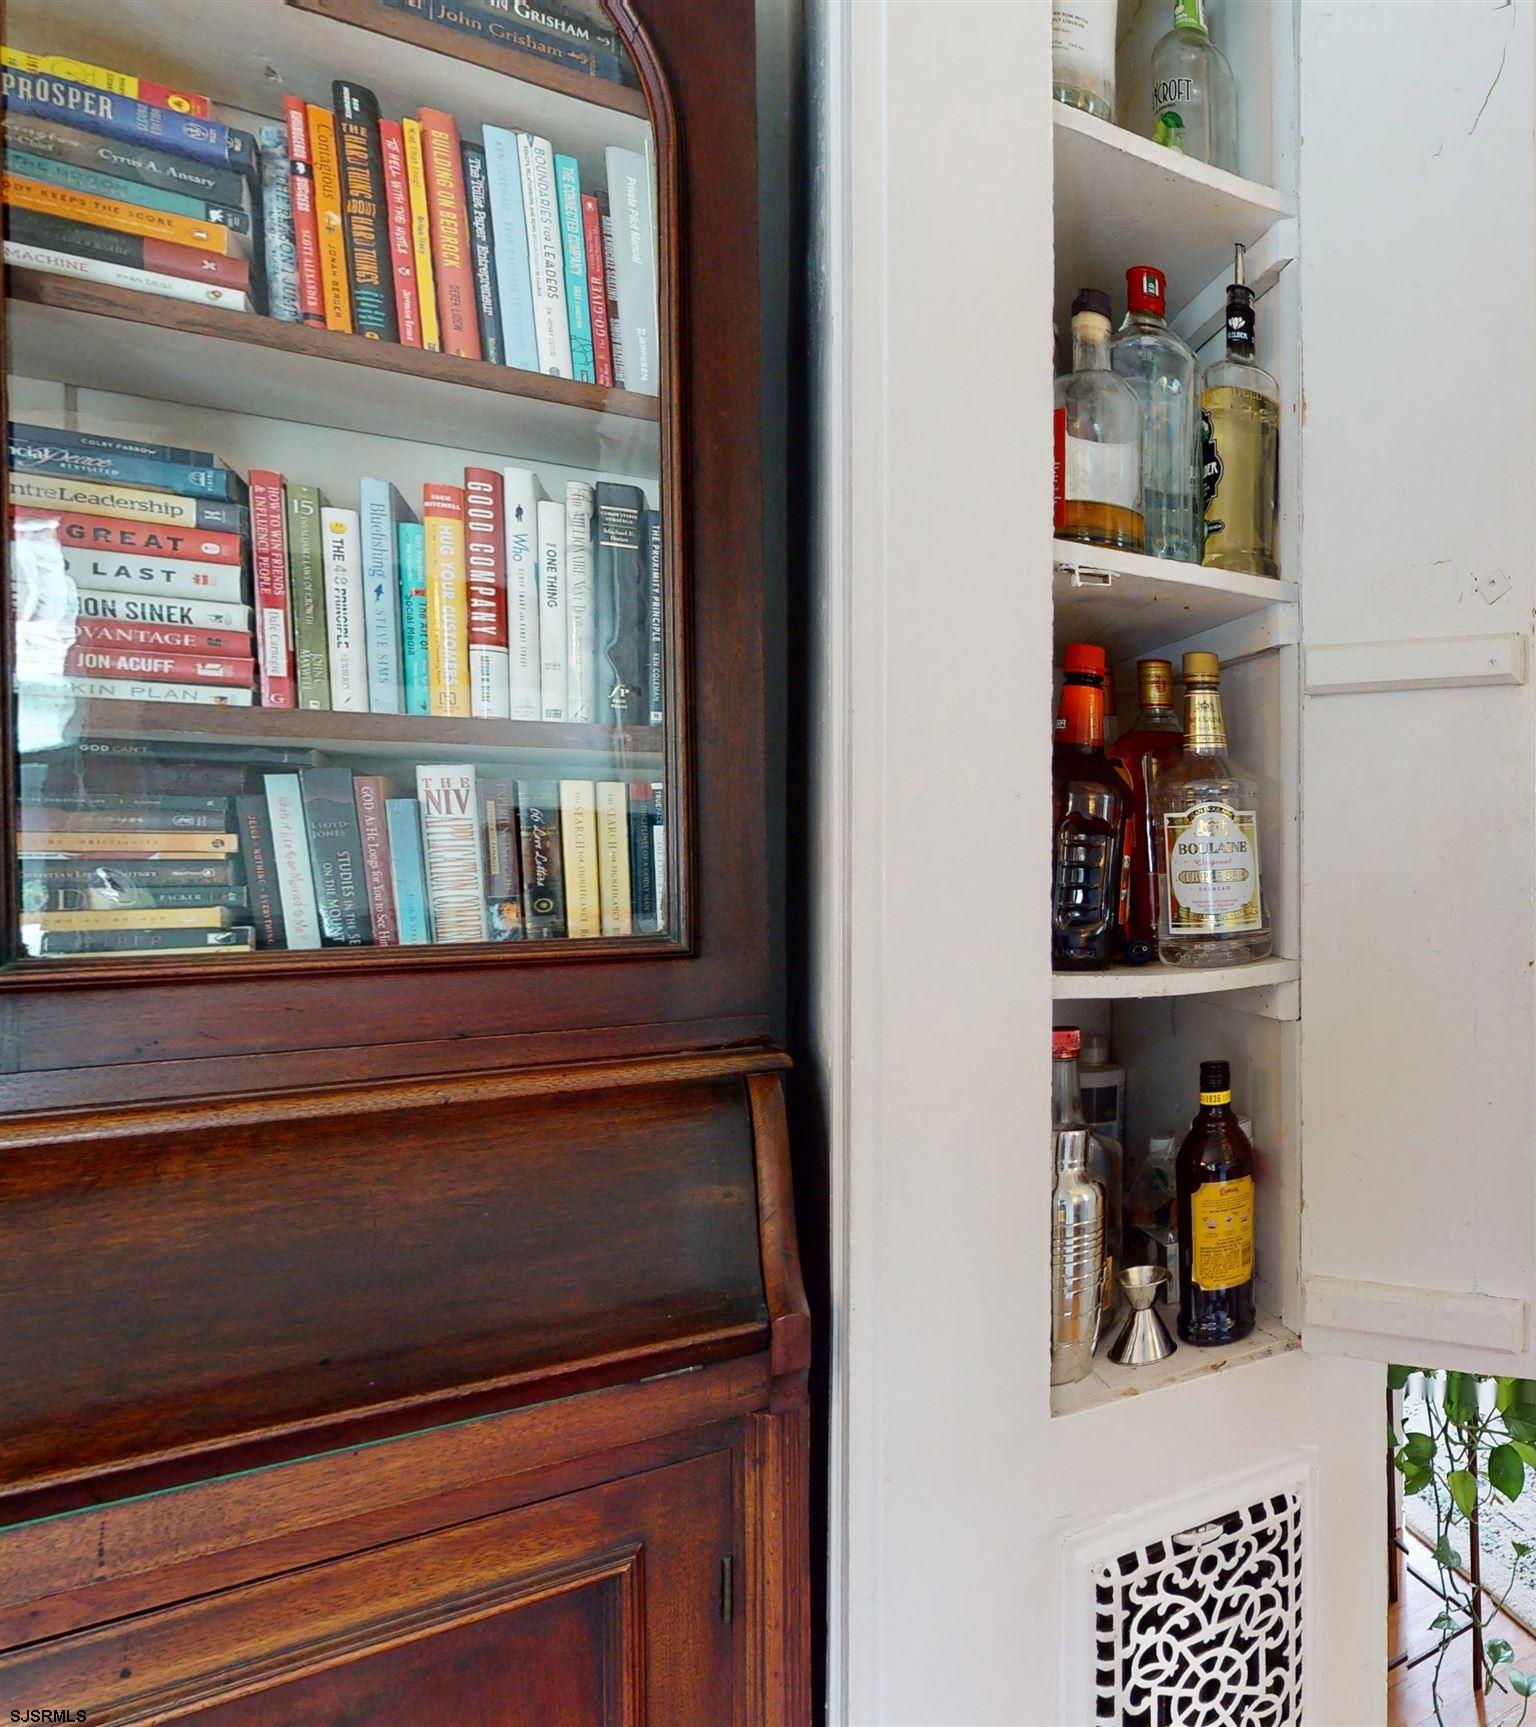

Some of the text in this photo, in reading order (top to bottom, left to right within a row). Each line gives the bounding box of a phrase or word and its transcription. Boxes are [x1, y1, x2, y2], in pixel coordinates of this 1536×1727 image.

[437, 2, 482, 32] John
[489, 23, 562, 58] Grisham
[514, 0, 589, 41] GRISHAM
[2, 72, 113, 120] PROSPER
[341, 122, 368, 136] THE
[386, 138, 399, 151] TO
[98, 149, 145, 168] Cyrus
[146, 161, 162, 174] A.
[167, 166, 216, 190] Ansary
[316, 124, 334, 200] Contagious
[344, 135, 368, 166] HARD
[388, 153, 402, 177] HELL
[347, 167, 372, 199] THING
[391, 181, 404, 204] WITH
[534, 148, 552, 224] BOUNDARIES
[562, 167, 577, 182] THE
[41, 189, 86, 206] KEEPS
[94, 201, 120, 214] THE
[128, 211, 176, 227] SCORE
[431, 130, 460, 269] BUILDING ON BEDROCK
[563, 183, 579, 231] CONNECTED
[626, 176, 642, 264] Private Pilot Manual
[277, 206, 294, 266] REASON
[351, 216, 379, 286] HARD THINGS
[395, 226, 409, 255] HUSTLE
[470, 158, 493, 316] The Toilet Paper Entrepreneur
[543, 226, 551, 242] FOR
[567, 233, 582, 277] COMPANY
[5, 247, 90, 273] MACHINE
[301, 230, 318, 307] SCOTT ALEXANDER
[328, 244, 342, 318] JONAH BERGER
[544, 245, 558, 299] LEADERS
[282, 277, 298, 320] JUMP
[591, 277, 606, 338] GO-GIVER
[48, 446, 112, 468] Peace
[10, 481, 184, 518] ntreLeadership
[66, 523, 184, 551] GREAT
[255, 496, 269, 554] INFLUENCE
[267, 487, 284, 596] HOW TO WIN FRIENDS
[369, 503, 386, 577] Bluefishing
[571, 511, 586, 576] MILLIONAIRE
[467, 481, 497, 636] GOOD COMPANY
[512, 533, 529, 562] Who
[546, 550, 557, 574] ONE
[92, 562, 176, 582] LAST
[259, 555, 271, 594] PEOPLE
[547, 575, 558, 609] THING
[651, 525, 661, 642] THE PRINCIPLE
[125, 601, 194, 625] SINEK
[332, 538, 349, 649] THE PRINCIPLE
[418, 602, 427, 619] The
[440, 525, 458, 686] HUG YOUR CUSTOMERS
[268, 611, 283, 674] Dale Carnegie
[405, 595, 416, 655] Social Media
[419, 623, 427, 638] Art
[77, 652, 175, 674] JON ACUFF
[312, 653, 324, 676] JOHN
[375, 610, 389, 684] STEVE SIMS
[300, 649, 313, 690] MAXWELL
[131, 686, 198, 702] PLAN
[79, 744, 110, 752] GOD
[422, 777, 470, 788] THE
[424, 789, 471, 816] NIV
[313, 829, 346, 838] JONES
[530, 808, 544, 822] 66
[574, 806, 585, 849] SEARCH
[607, 806, 618, 849] SEARCH
[640, 805, 649, 849] DISCIPLINES
[425, 816, 478, 892] APPLICATION
[534, 851, 547, 887] Letters
[642, 850, 649, 860] OF
[1178, 841, 1247, 855] BOULAINE
[337, 850, 357, 930] STUDIES IN THE
[365, 816, 388, 929] As He Longs for You to See
[578, 865, 588, 922] SIGNIFICANCE
[611, 865, 620, 921] SIGNIFICANCE
[322, 863, 345, 942] ON THE MOUNT
